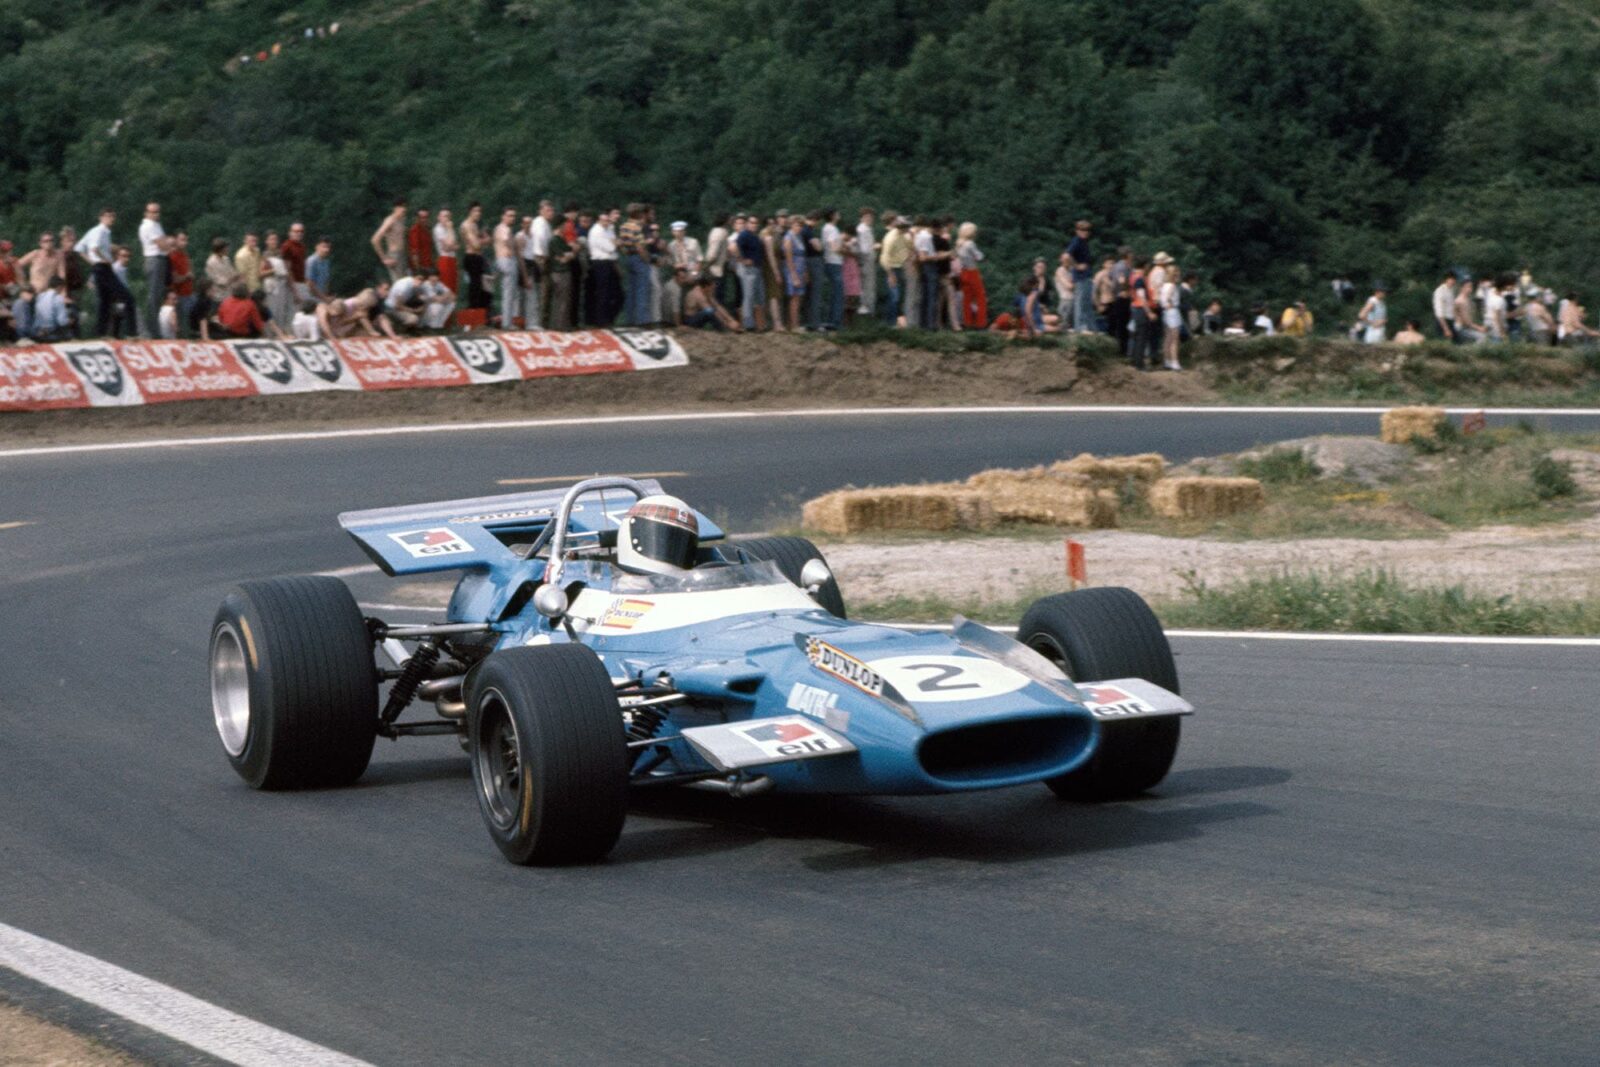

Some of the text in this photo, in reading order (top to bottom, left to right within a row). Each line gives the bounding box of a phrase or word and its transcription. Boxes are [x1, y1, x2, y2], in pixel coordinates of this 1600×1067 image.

[341, 338, 439, 366] super
[456, 340, 499, 366] BP
[502, 331, 602, 357] super
[622, 331, 666, 351] BP
[75, 354, 117, 383] BP
[122, 343, 224, 375] super
[242, 349, 289, 374] BP
[294, 347, 337, 373] BP
[419, 543, 462, 554] elf
[822, 648, 882, 691] DUNLOP
[902, 663, 982, 692] 2
[1093, 702, 1144, 716] elf
[776, 737, 829, 756] elf
